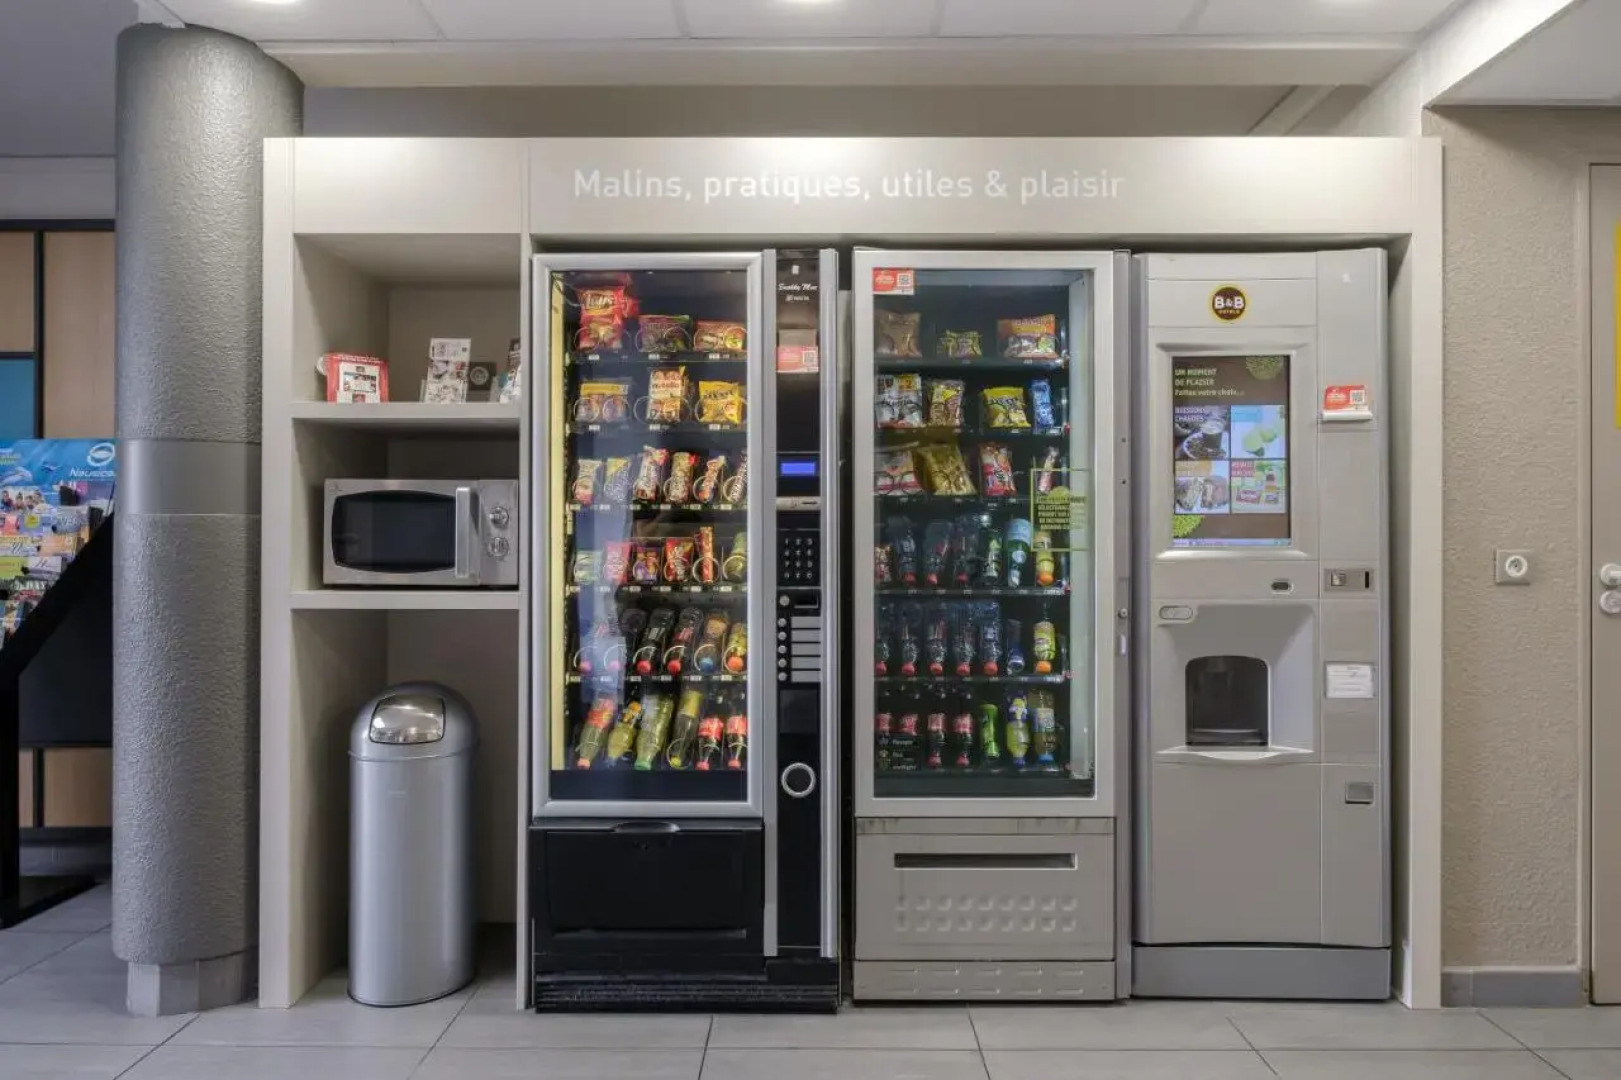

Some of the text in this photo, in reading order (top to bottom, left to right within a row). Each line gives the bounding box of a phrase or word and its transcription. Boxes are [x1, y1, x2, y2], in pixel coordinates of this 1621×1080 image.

[574, 168, 1125, 206] Malins, pratiques, utiles & plaisir
[1215, 296, 1245, 309] B&B
[1187, 367, 1217, 376] MOMENT
